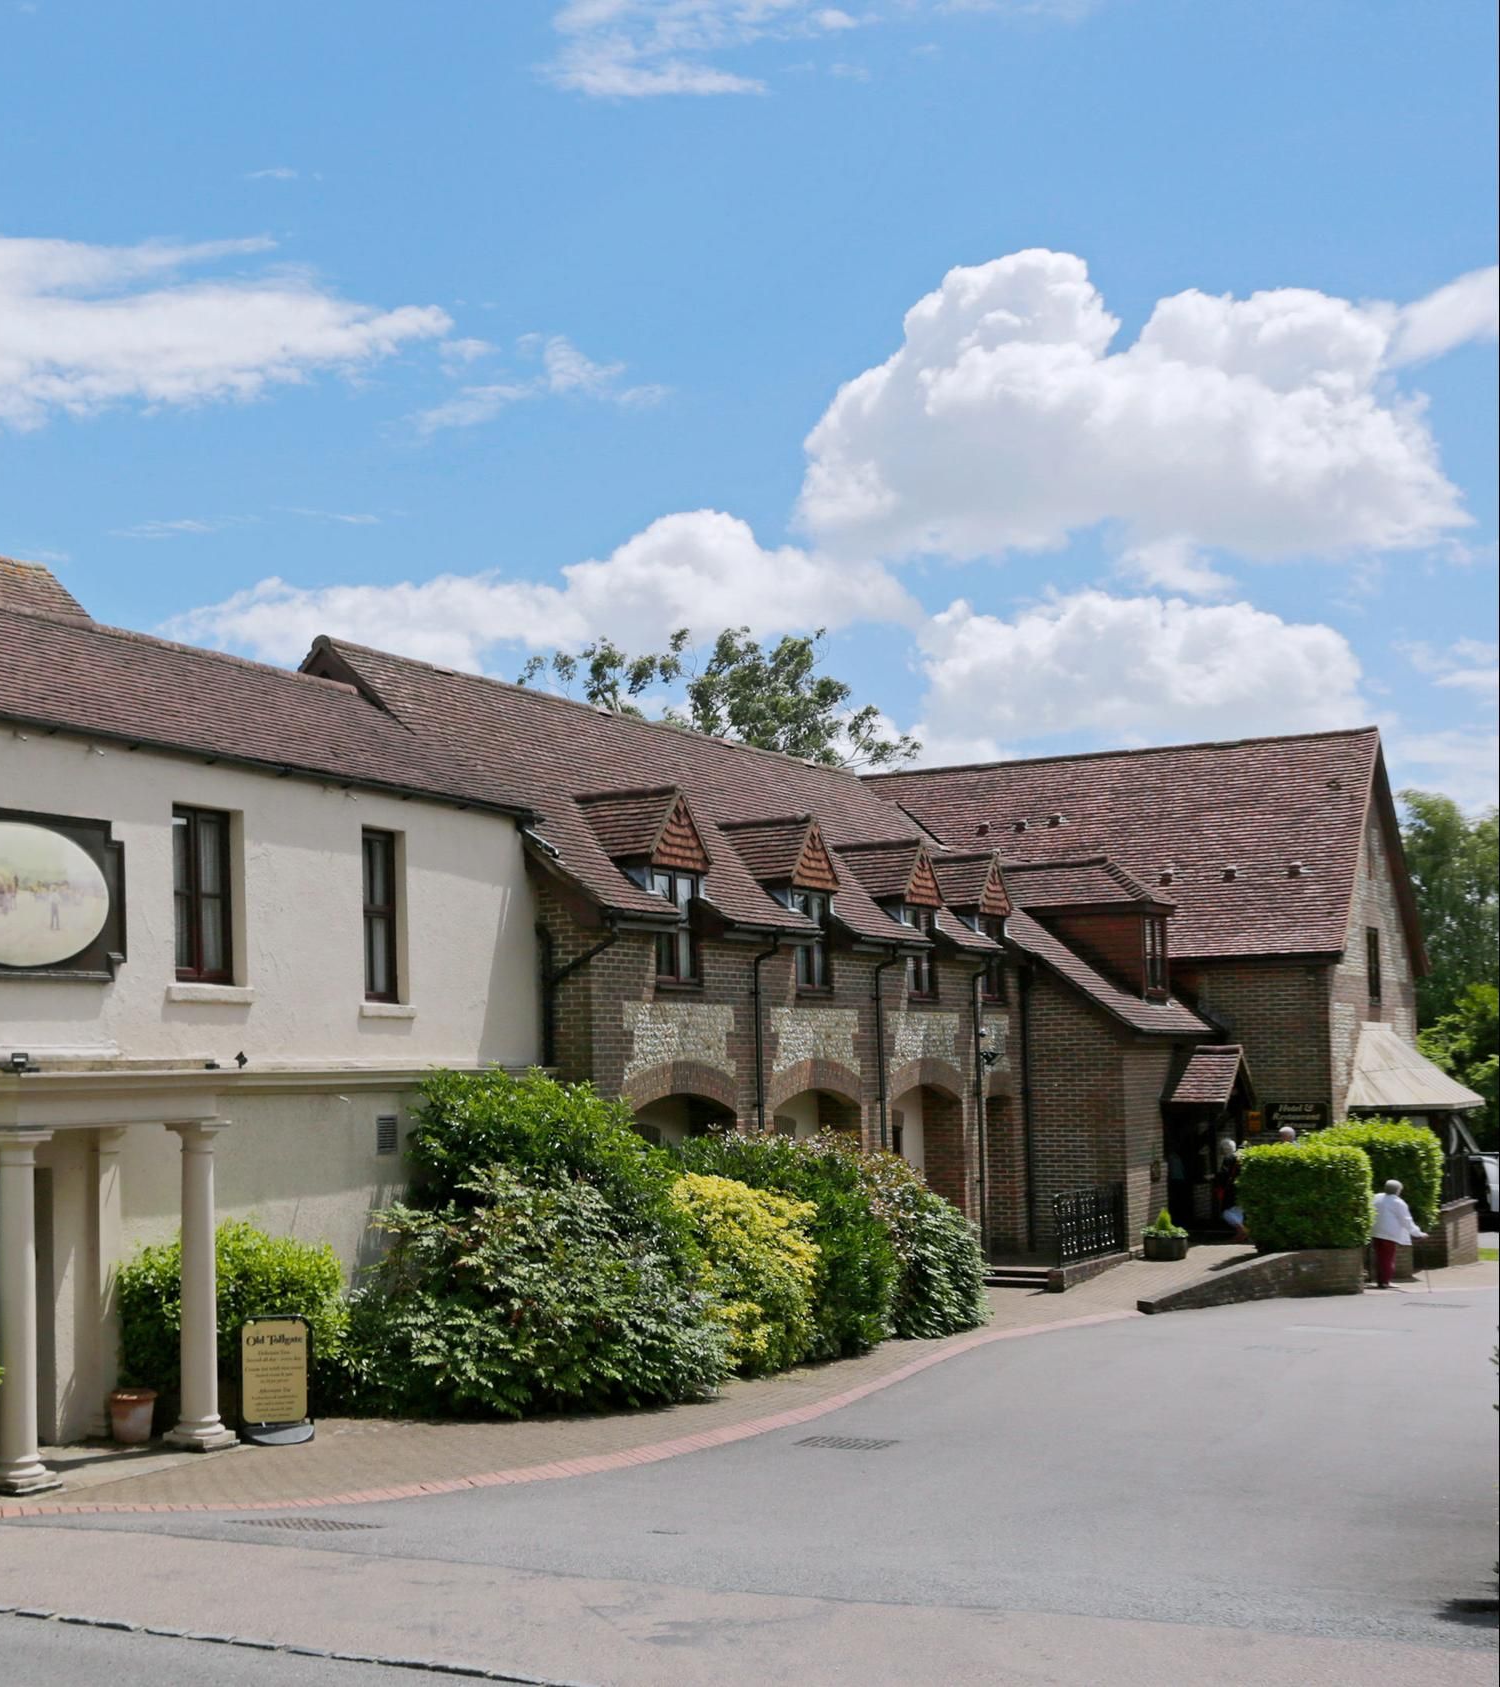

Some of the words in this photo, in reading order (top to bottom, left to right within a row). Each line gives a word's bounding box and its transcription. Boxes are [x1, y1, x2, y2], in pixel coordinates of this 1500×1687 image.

[1278, 1103, 1303, 1112] Hotel
[1272, 1112, 1321, 1121] Restaurant
[246, 1335, 265, 1346] Old
[266, 1334, 302, 1346] Tollgate
